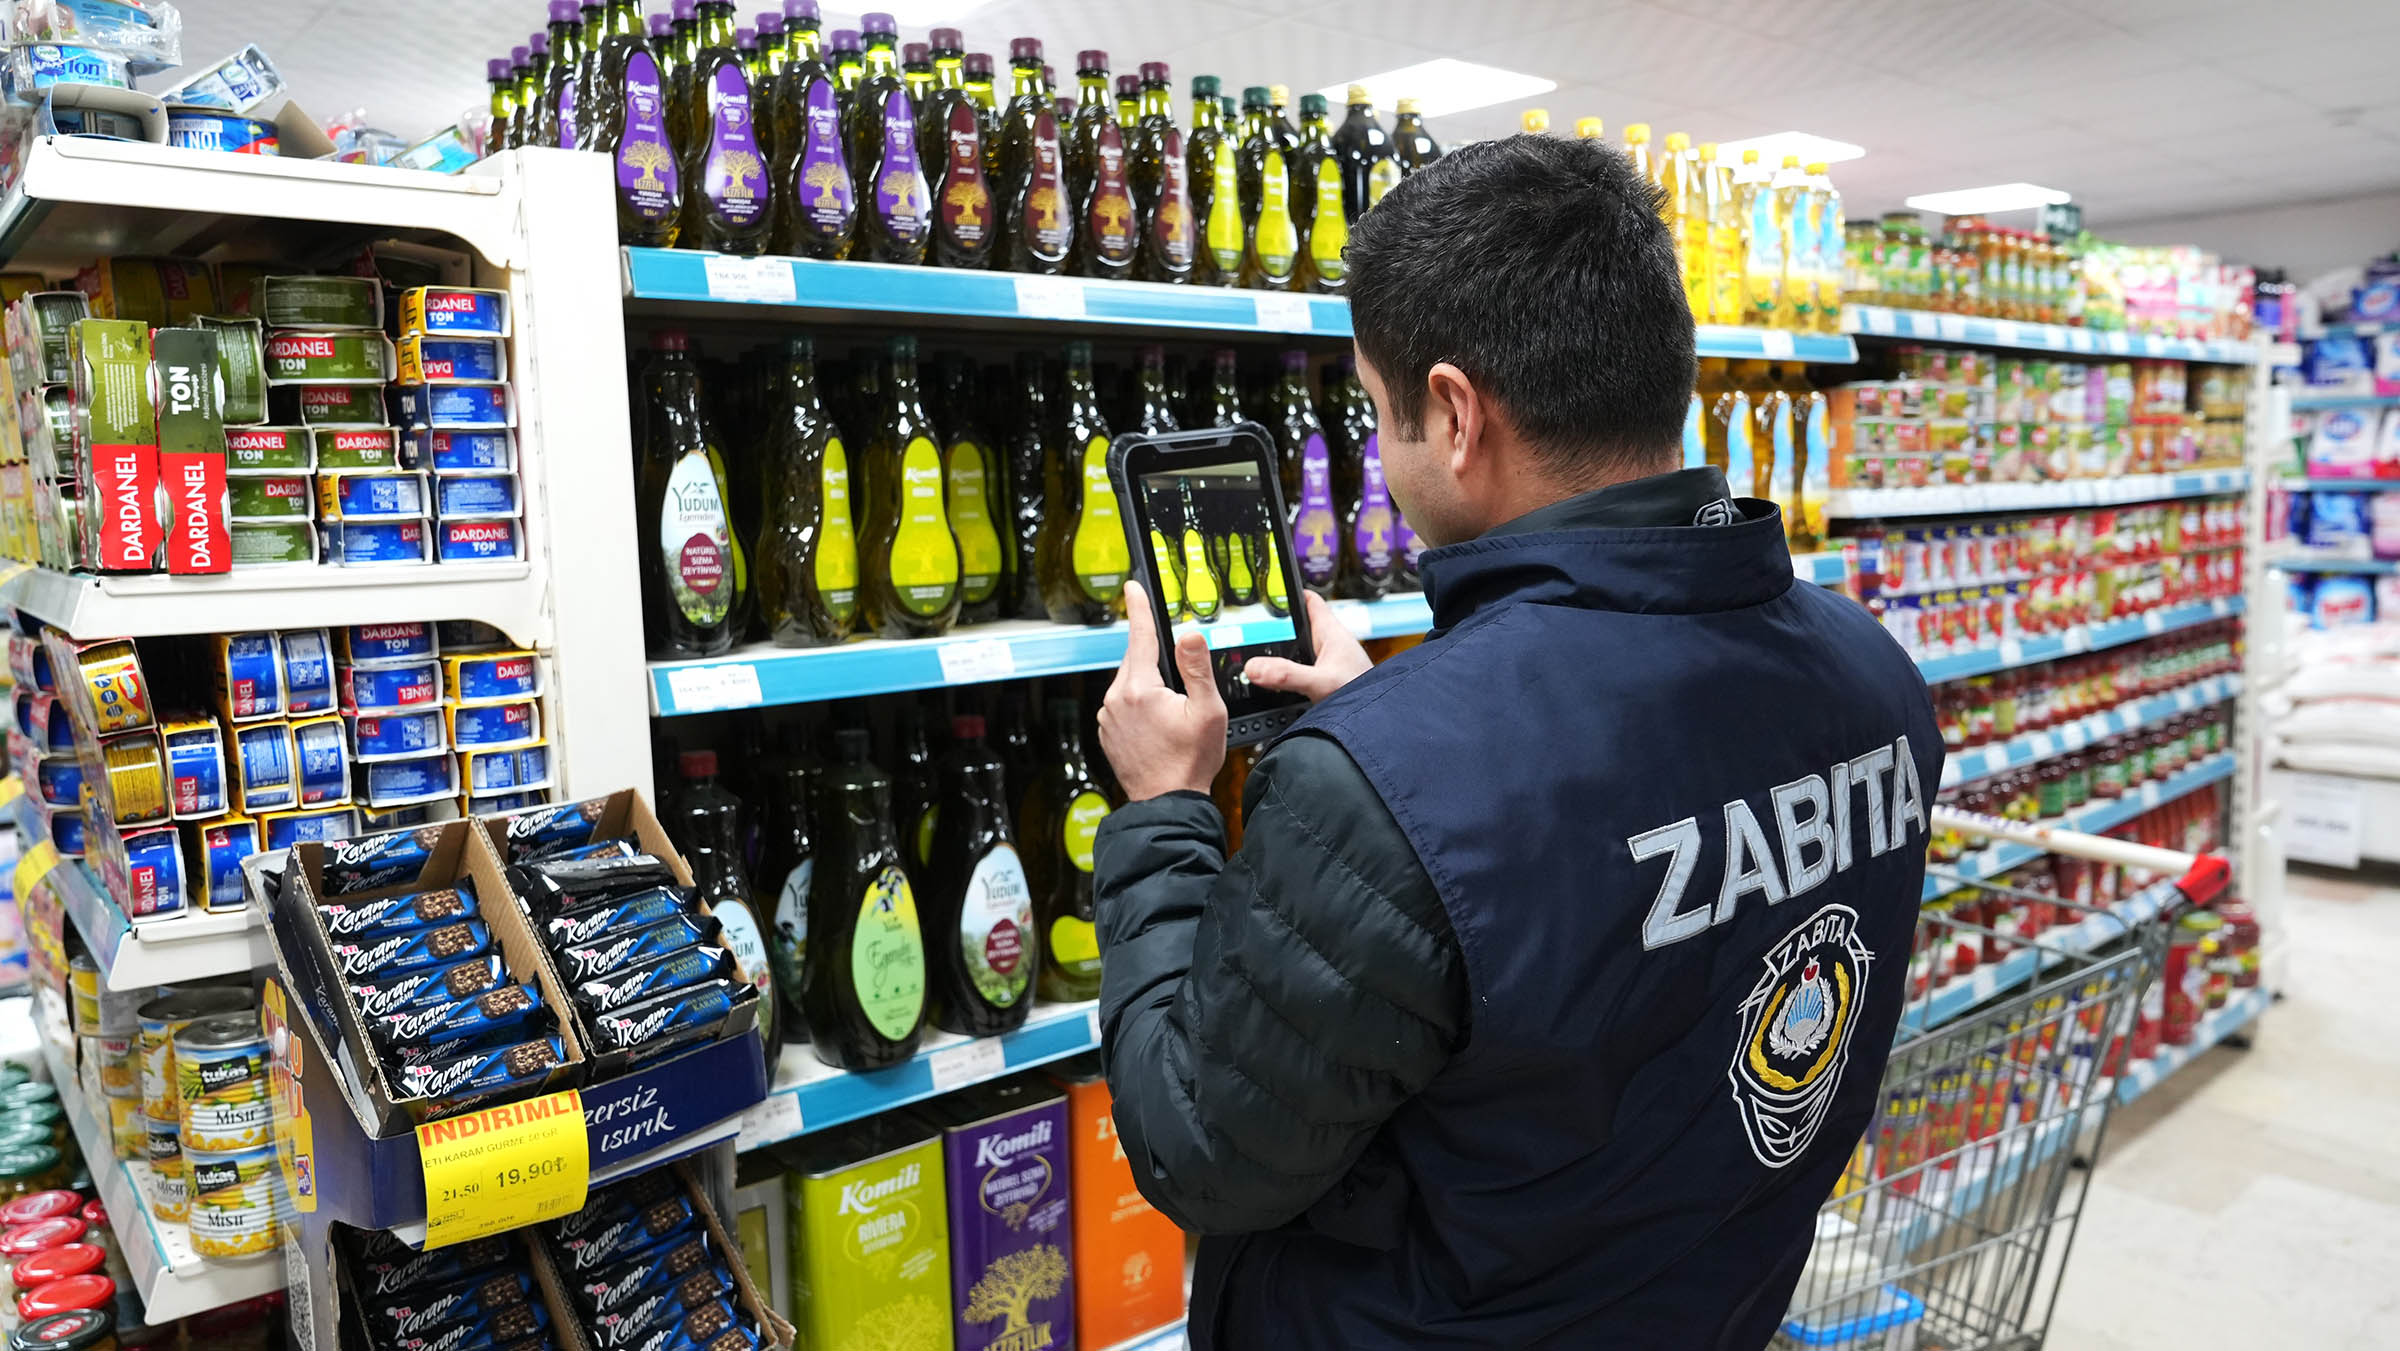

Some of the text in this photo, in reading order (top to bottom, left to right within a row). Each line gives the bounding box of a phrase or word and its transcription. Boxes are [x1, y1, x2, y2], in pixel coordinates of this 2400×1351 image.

[627, 80, 659, 97] Komili
[429, 311, 455, 322] TON
[278, 358, 307, 371] TON
[169, 366, 192, 415] TON
[306, 405, 329, 415] TON
[236, 450, 264, 460] TON
[359, 450, 382, 460] TON
[115, 452, 145, 561] DARDANEL
[184, 460, 212, 568] DARDANEL
[672, 481, 720, 513] YUDUM
[450, 528, 508, 541] DARDANEL
[472, 542, 497, 552] TON
[362, 624, 423, 639] DARDANEL
[384, 640, 410, 650] TON
[506, 808, 564, 839] Karam
[336, 833, 398, 865] Karam
[1626, 735, 1928, 951] ZABITA
[329, 898, 398, 934] Karam
[354, 911, 383, 932] GURME
[566, 908, 618, 944] Karam
[342, 936, 411, 976] Karam
[368, 950, 396, 972] GURME
[588, 938, 638, 976] Karam
[1775, 914, 1852, 976] ZABITA
[360, 975, 430, 1017] Karam
[386, 990, 414, 1013] GURME
[602, 971, 653, 1012] Karam
[392, 1002, 462, 1040] Karam
[418, 1012, 447, 1036] GURME
[622, 1006, 674, 1047] Karam
[417, 1055, 488, 1098] Karam
[442, 1068, 473, 1094] GURME
[601, 1106, 677, 1152] ısırık
[975, 1120, 1053, 1168] Komili
[444, 1148, 484, 1163] KARAM
[486, 1136, 525, 1152] GURME
[837, 1162, 921, 1216] Komili
[576, 1222, 630, 1270] Karam
[376, 1250, 442, 1295] Karam
[596, 1266, 652, 1312] Karam
[394, 1293, 462, 1340] Karam
[609, 1296, 665, 1348] Karam
